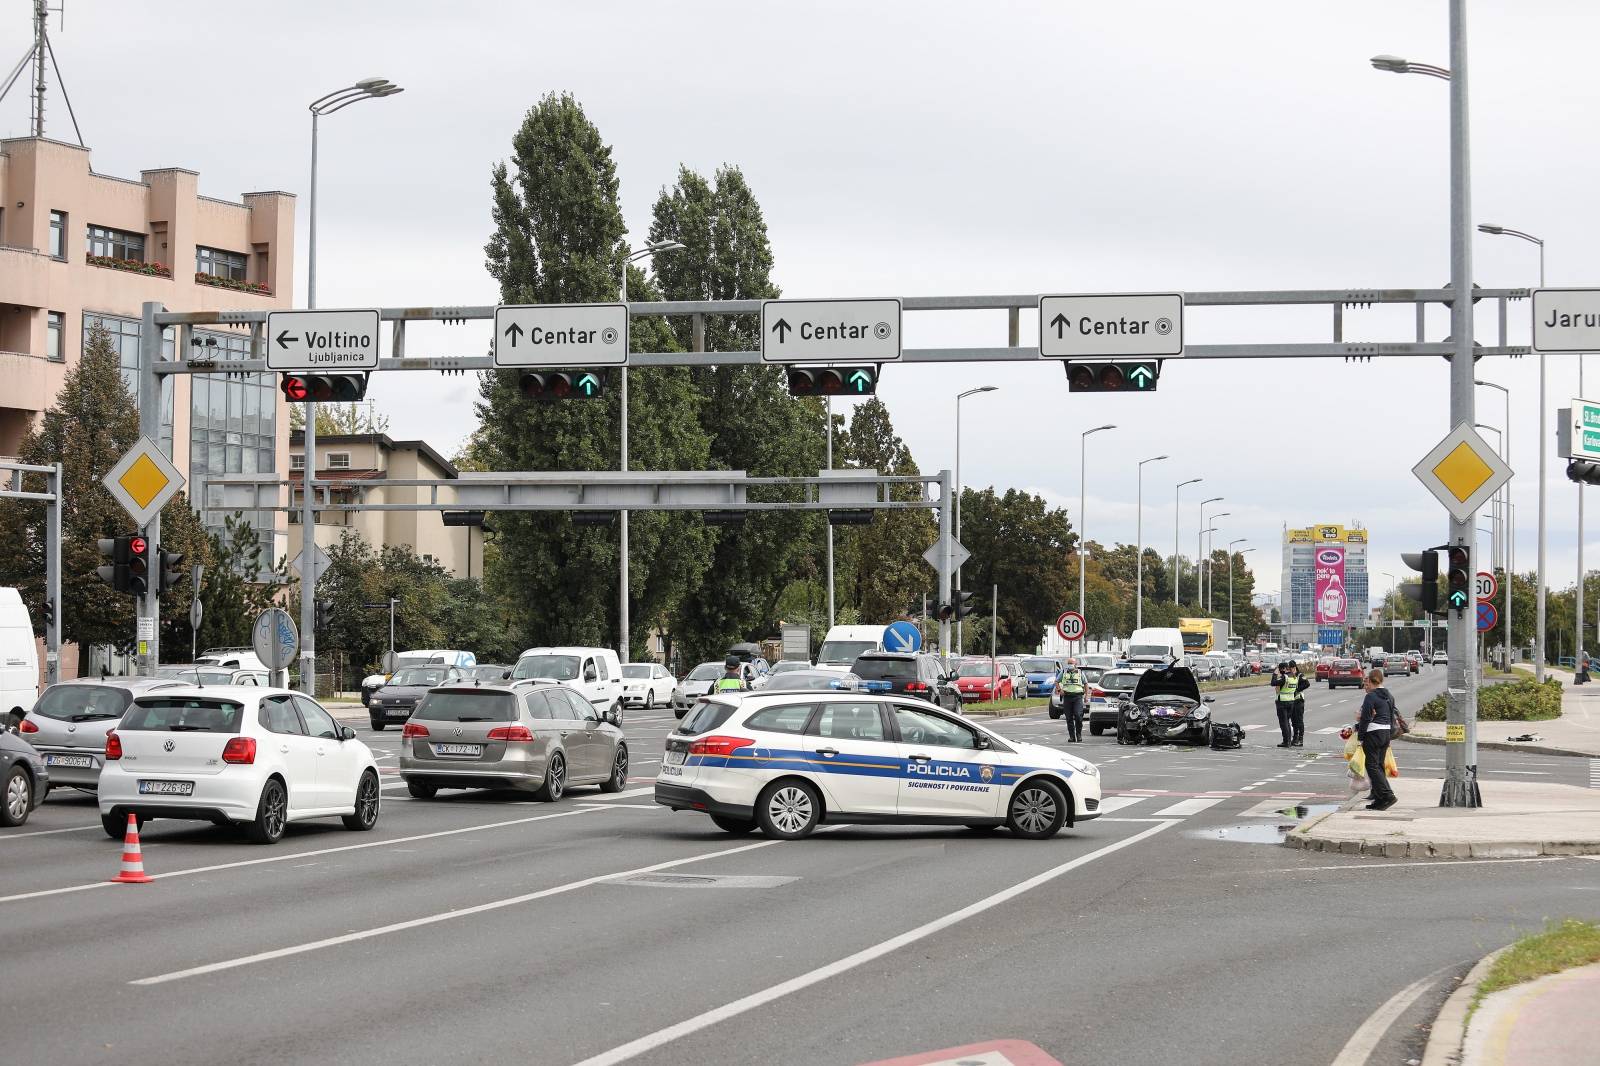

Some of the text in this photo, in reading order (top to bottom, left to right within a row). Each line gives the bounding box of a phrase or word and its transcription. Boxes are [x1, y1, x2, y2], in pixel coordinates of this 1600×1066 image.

[1079, 317, 1149, 336] Centar
[1545, 309, 1600, 328] Jaru
[531, 327, 597, 345] Centar
[801, 321, 869, 340] Centar
[305, 331, 371, 349] Voltino
[308, 352, 365, 363] Ljubljanica
[1063, 619, 1079, 634] 60
[907, 763, 970, 777] POLICIJA
[145, 782, 191, 793] SI 226-GP
[908, 781, 945, 790] SIGURNOST
[950, 784, 990, 793] POVJERENJE
